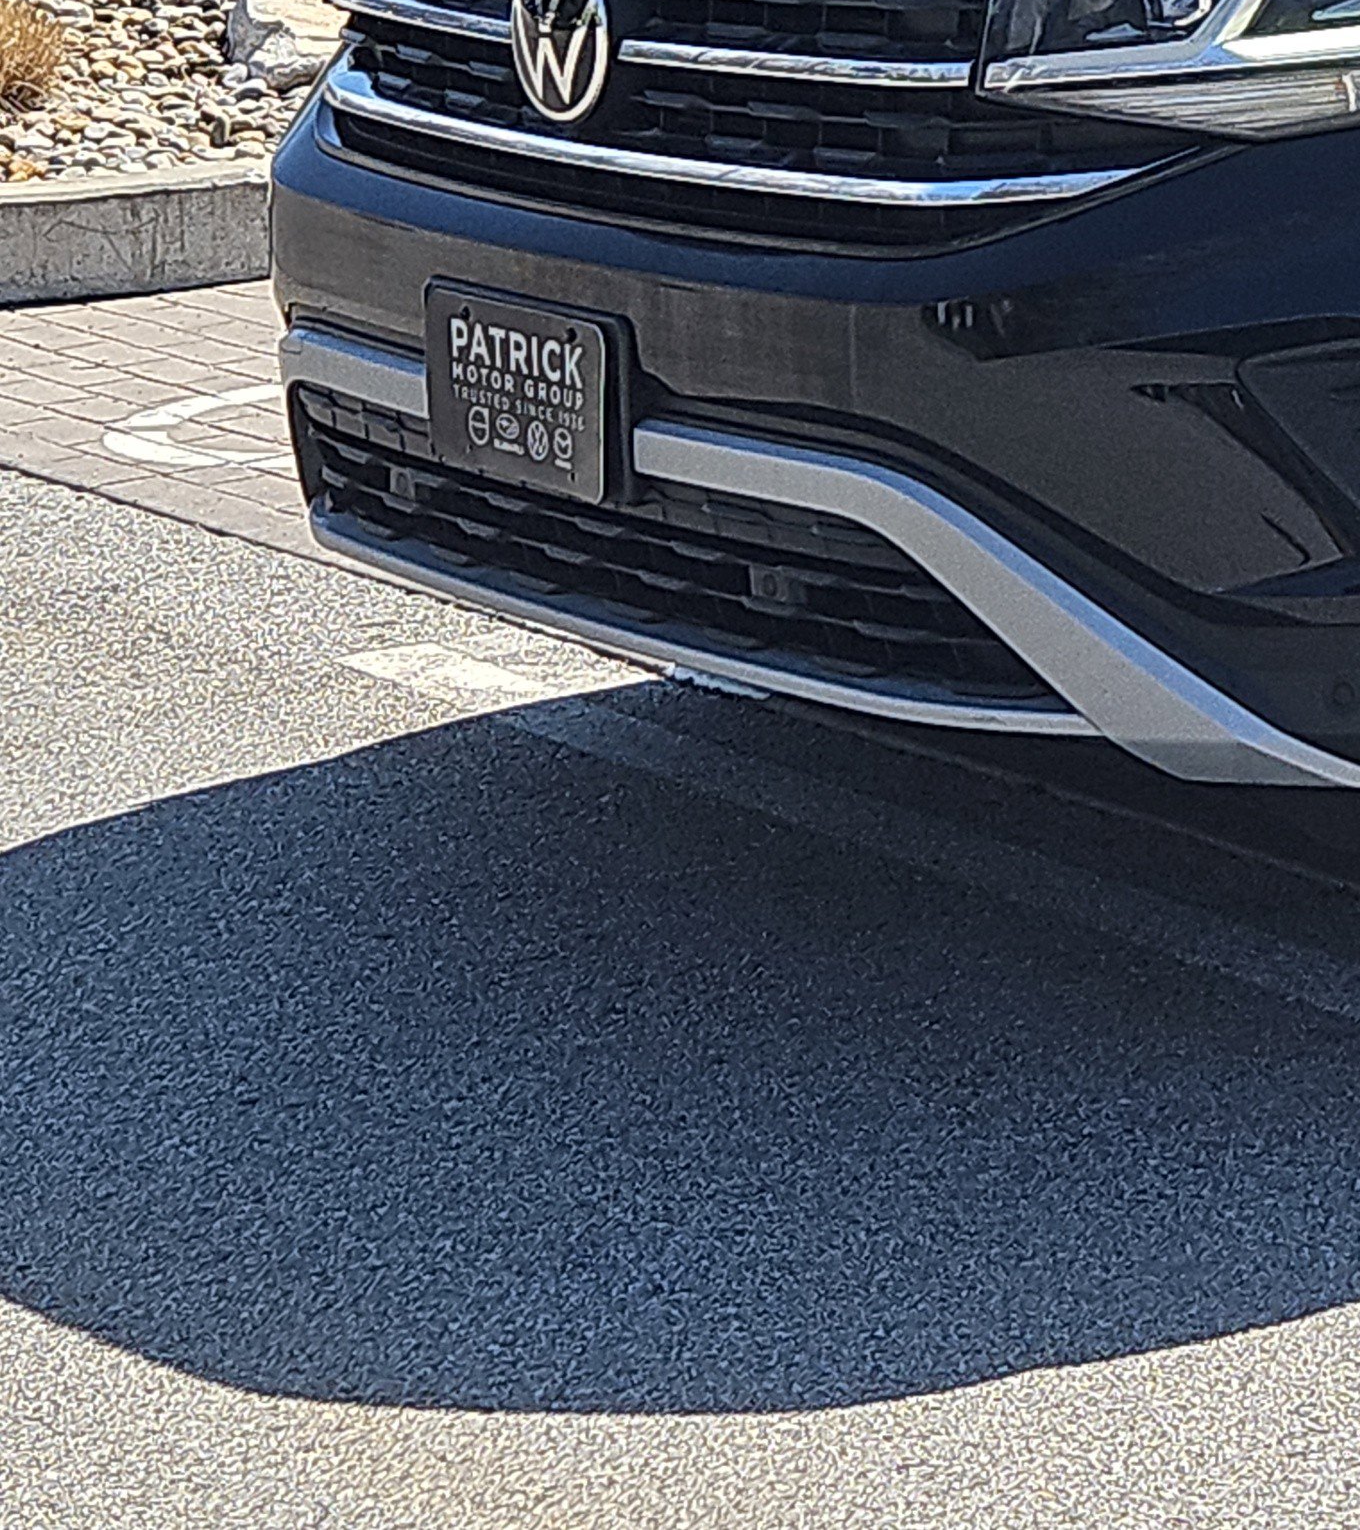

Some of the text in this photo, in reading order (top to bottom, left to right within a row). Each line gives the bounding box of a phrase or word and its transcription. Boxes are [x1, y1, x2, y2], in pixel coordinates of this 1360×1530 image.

[450, 317, 583, 389] PATRICK
[452, 362, 584, 411] MOTOR GROUP
[453, 383, 510, 411] TRUSTED
[515, 399, 554, 423] SINCE
